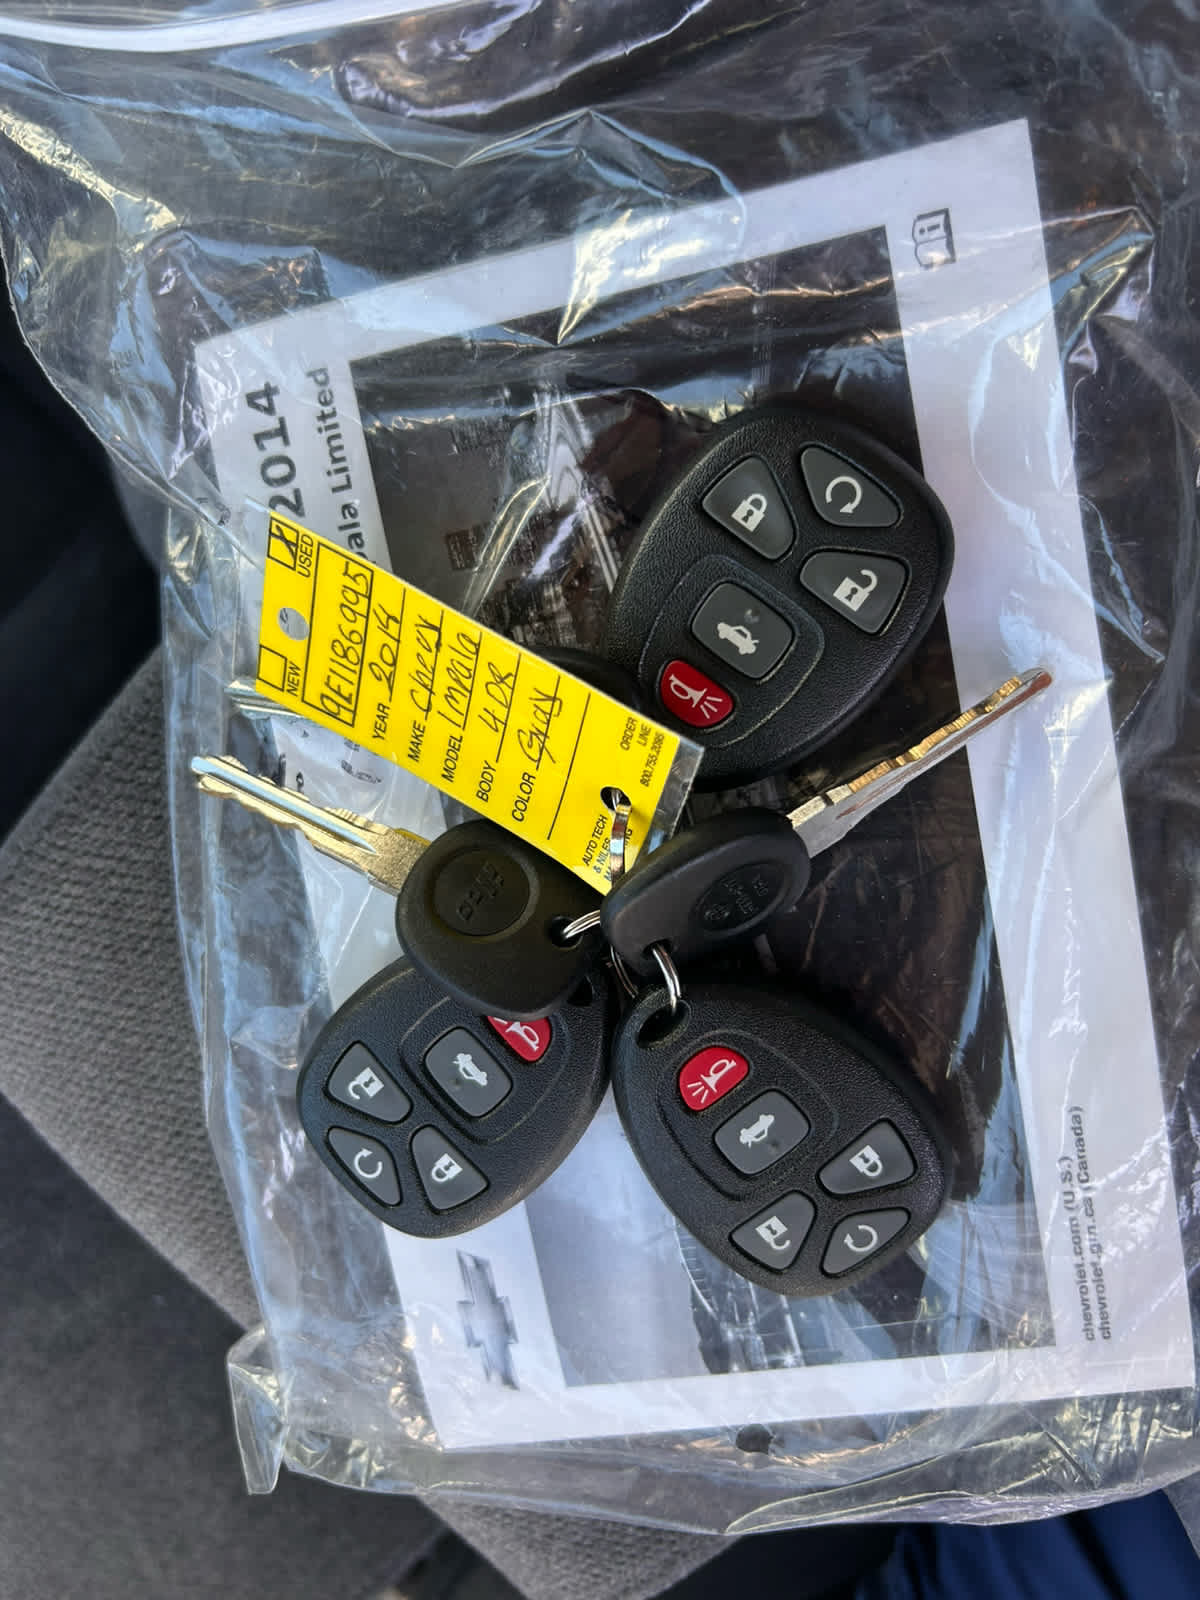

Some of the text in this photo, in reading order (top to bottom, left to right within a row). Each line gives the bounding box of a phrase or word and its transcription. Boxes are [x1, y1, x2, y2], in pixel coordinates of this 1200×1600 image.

[246, 382, 305, 518] 2014
[306, 367, 352, 494] Limited
[297, 534, 314, 578] USED
[368, 604, 401, 693] 2014
[286, 662, 302, 697] NEW
[372, 702, 391, 741] YEAR
[407, 720, 427, 762] MAKE
[619, 717, 638, 751] ORDER
[637, 724, 651, 747] LINE
[440, 734, 464, 783] MODEL
[475, 760, 498, 803] BODY
[511, 772, 537, 822] COLOR
[582, 814, 609, 866] AUTO TECH
[1058, 1155, 1096, 1342] chevrolet.com (U.S.)
